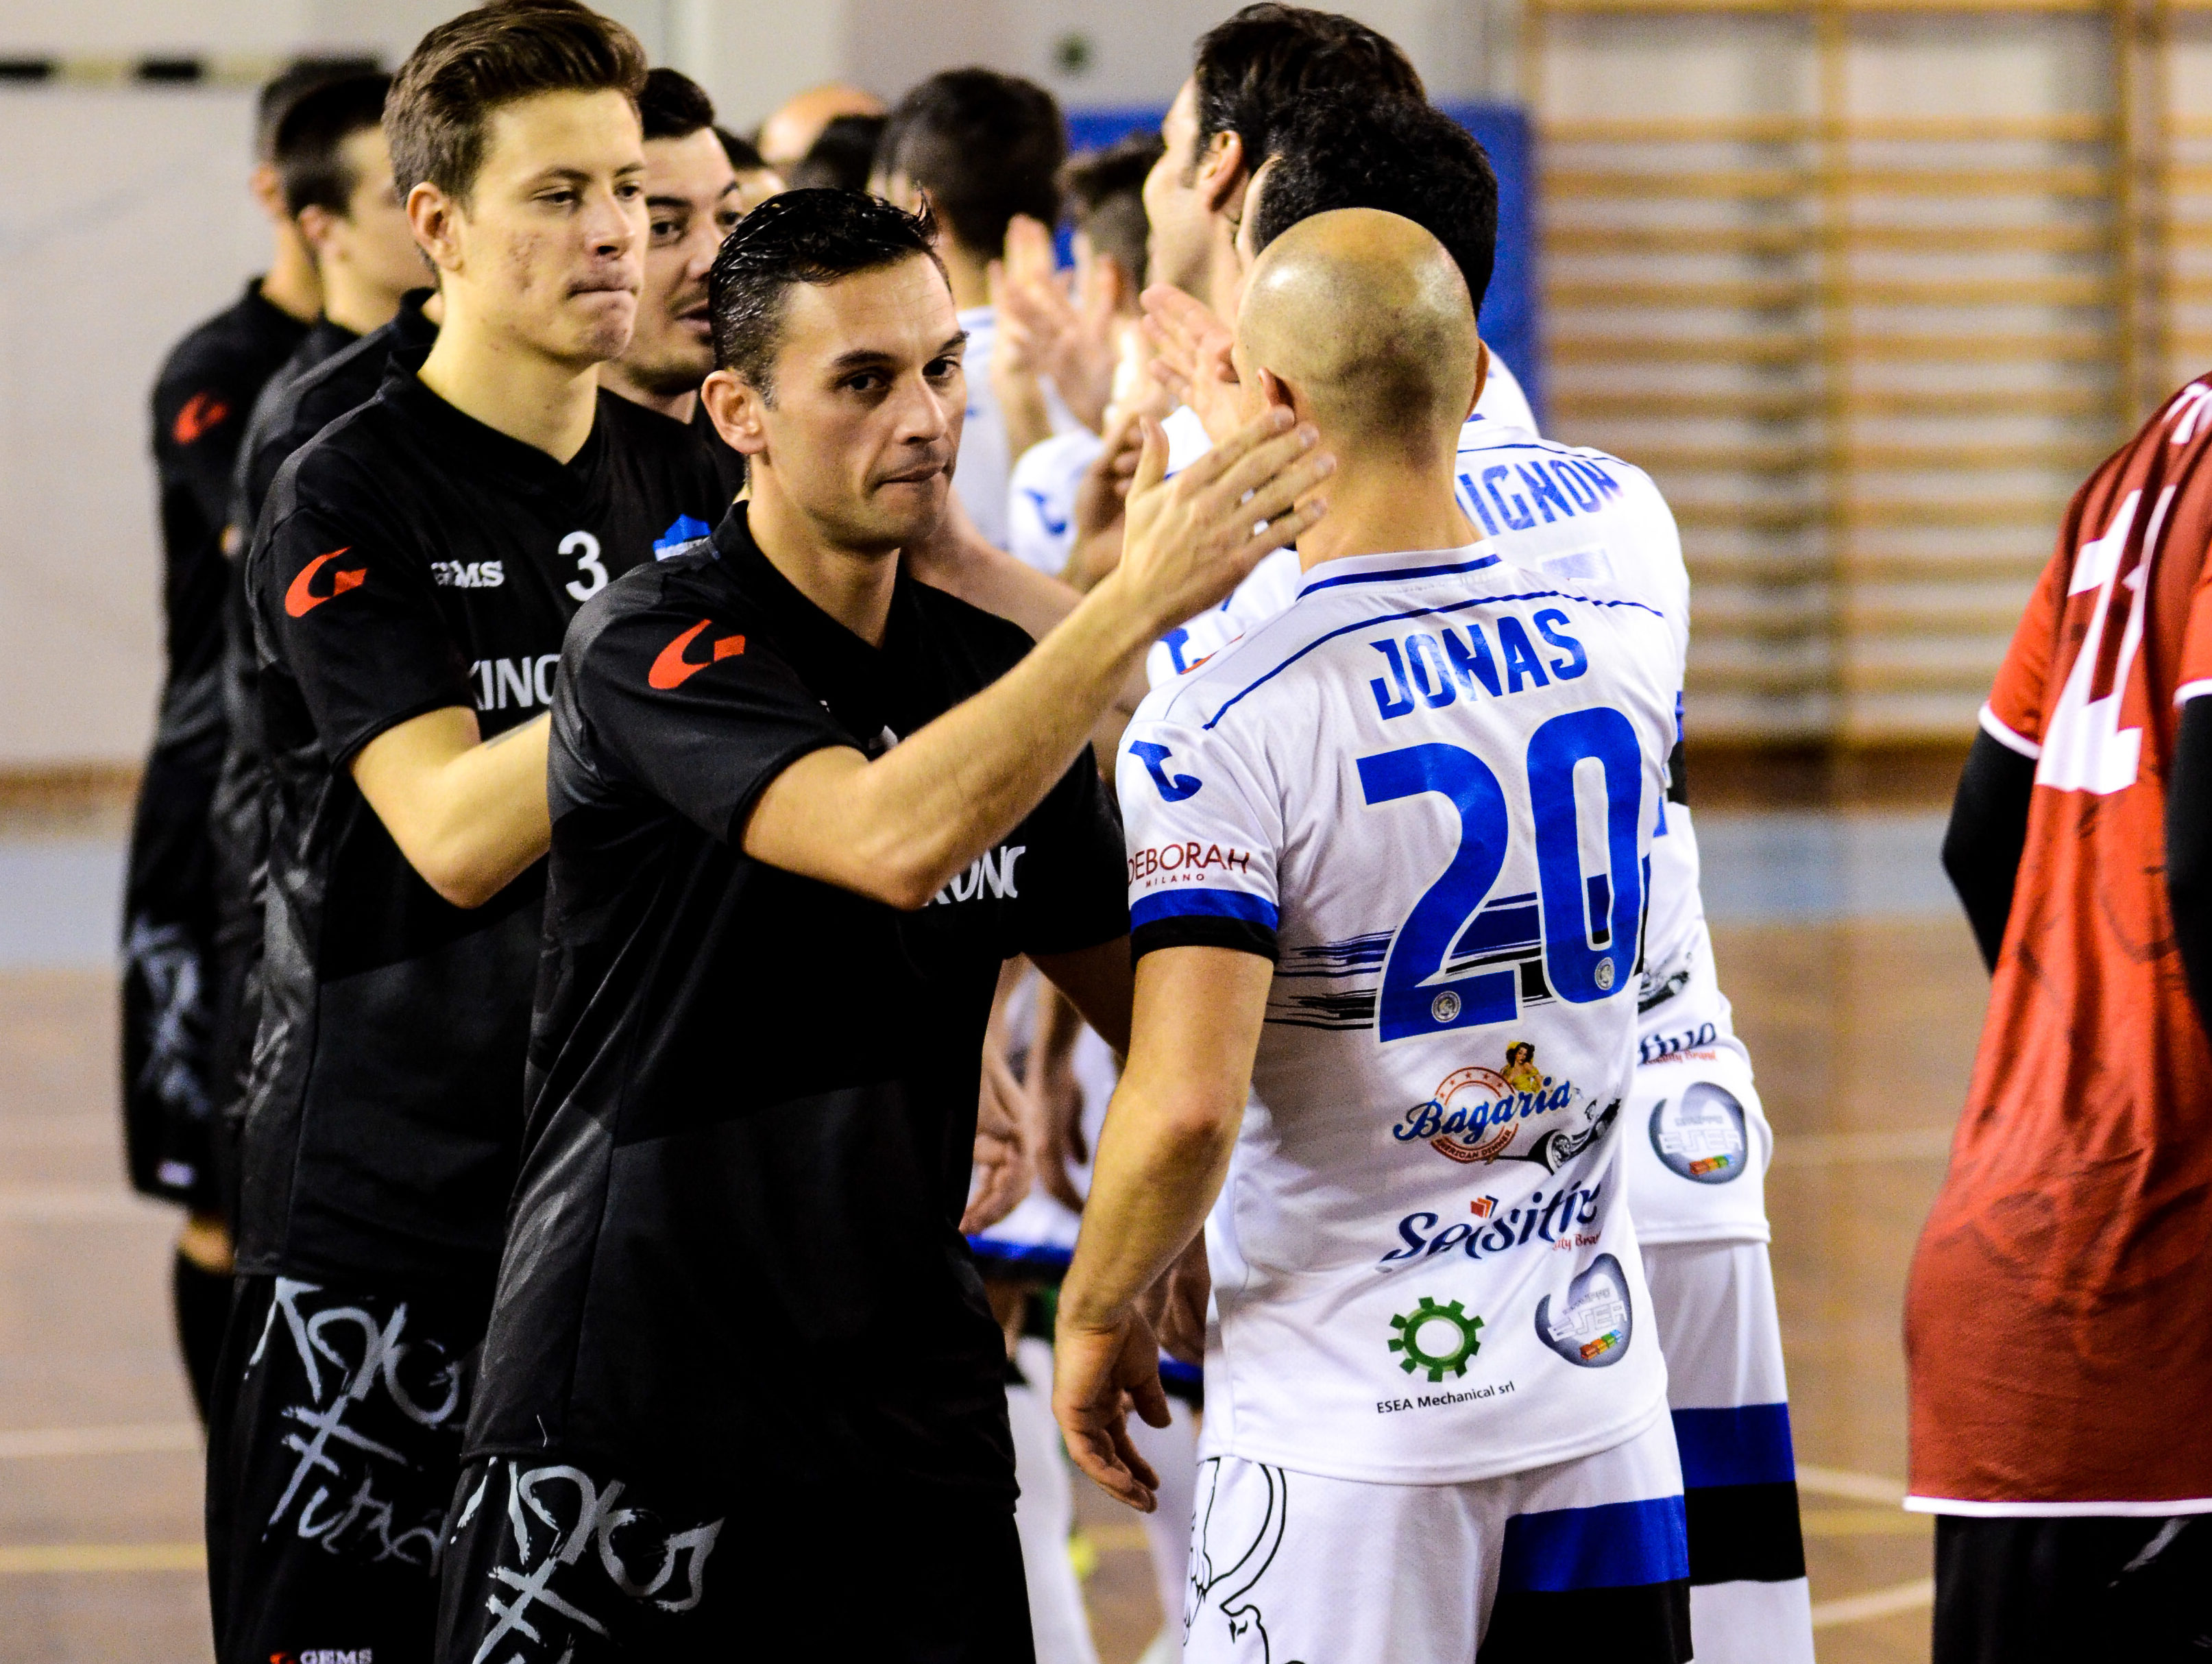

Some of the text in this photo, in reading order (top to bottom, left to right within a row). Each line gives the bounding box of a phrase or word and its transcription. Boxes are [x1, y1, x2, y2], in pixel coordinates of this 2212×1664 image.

[1454, 459, 1624, 536] IGNON
[557, 530, 609, 602] 3
[1369, 608, 1588, 720] JONAS
[1128, 842, 1250, 887] DEBORAH
[1145, 873, 1205, 888] MILANO
[1355, 706, 1642, 1043] 20
[1392, 1076, 1572, 1144] Bagaria
[1376, 1381, 1515, 1414] ESEA Mechanical srl
